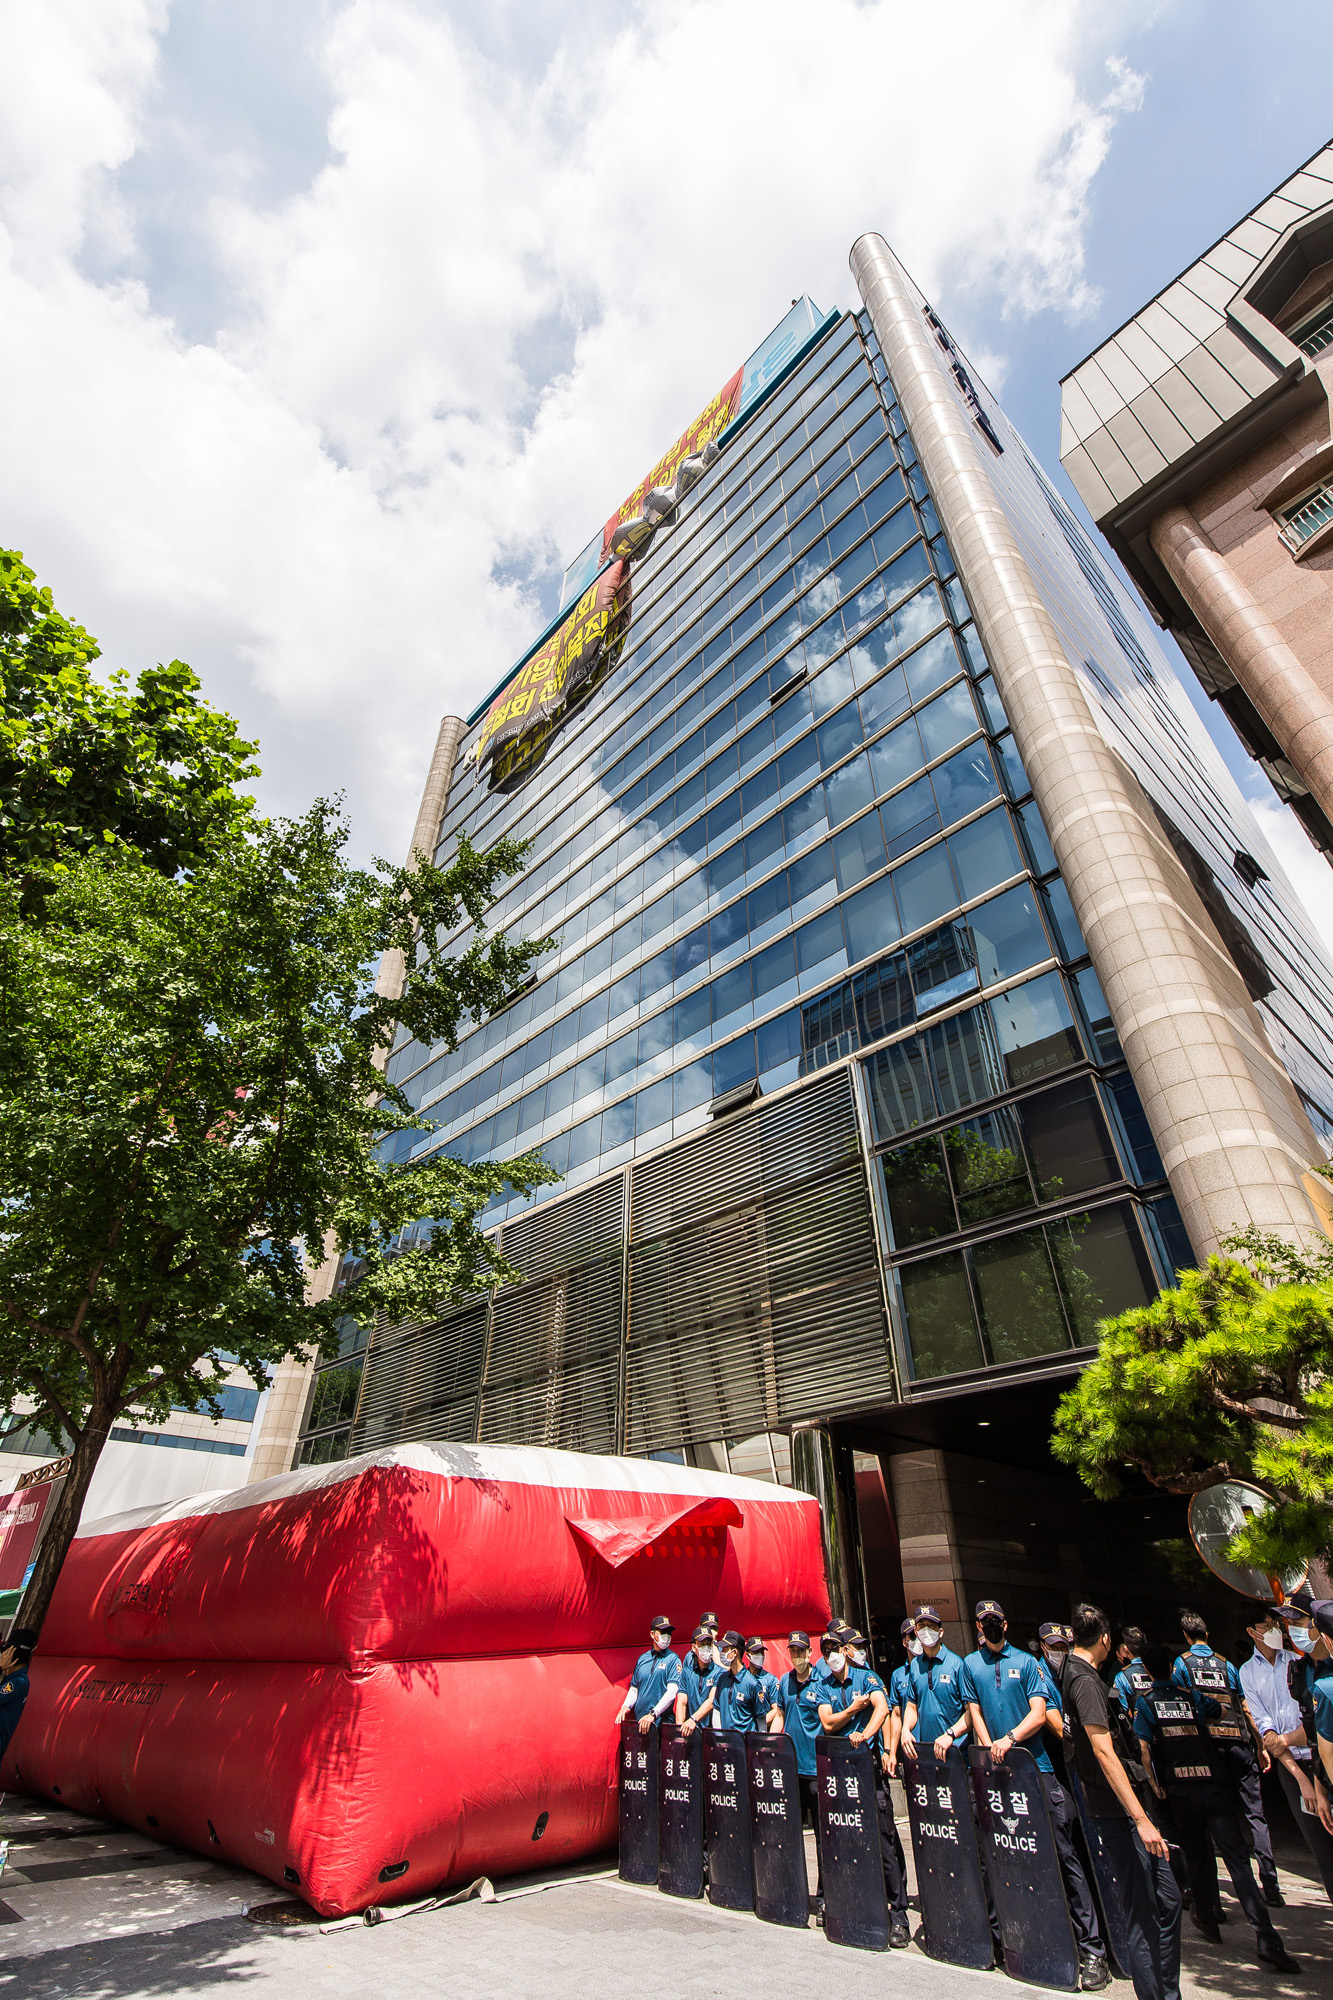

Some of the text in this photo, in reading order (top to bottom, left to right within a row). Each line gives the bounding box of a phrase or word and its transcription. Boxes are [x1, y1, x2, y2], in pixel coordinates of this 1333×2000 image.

[624, 1779, 647, 1791] POLICE
[665, 1789, 689, 1802] POLICE
[711, 1794, 737, 1808] POLICE
[757, 1802, 786, 1815] POLICE
[828, 1812, 862, 1827] POLICE
[920, 1822, 957, 1840] POLICE
[994, 1833, 1038, 1852] POLICE
